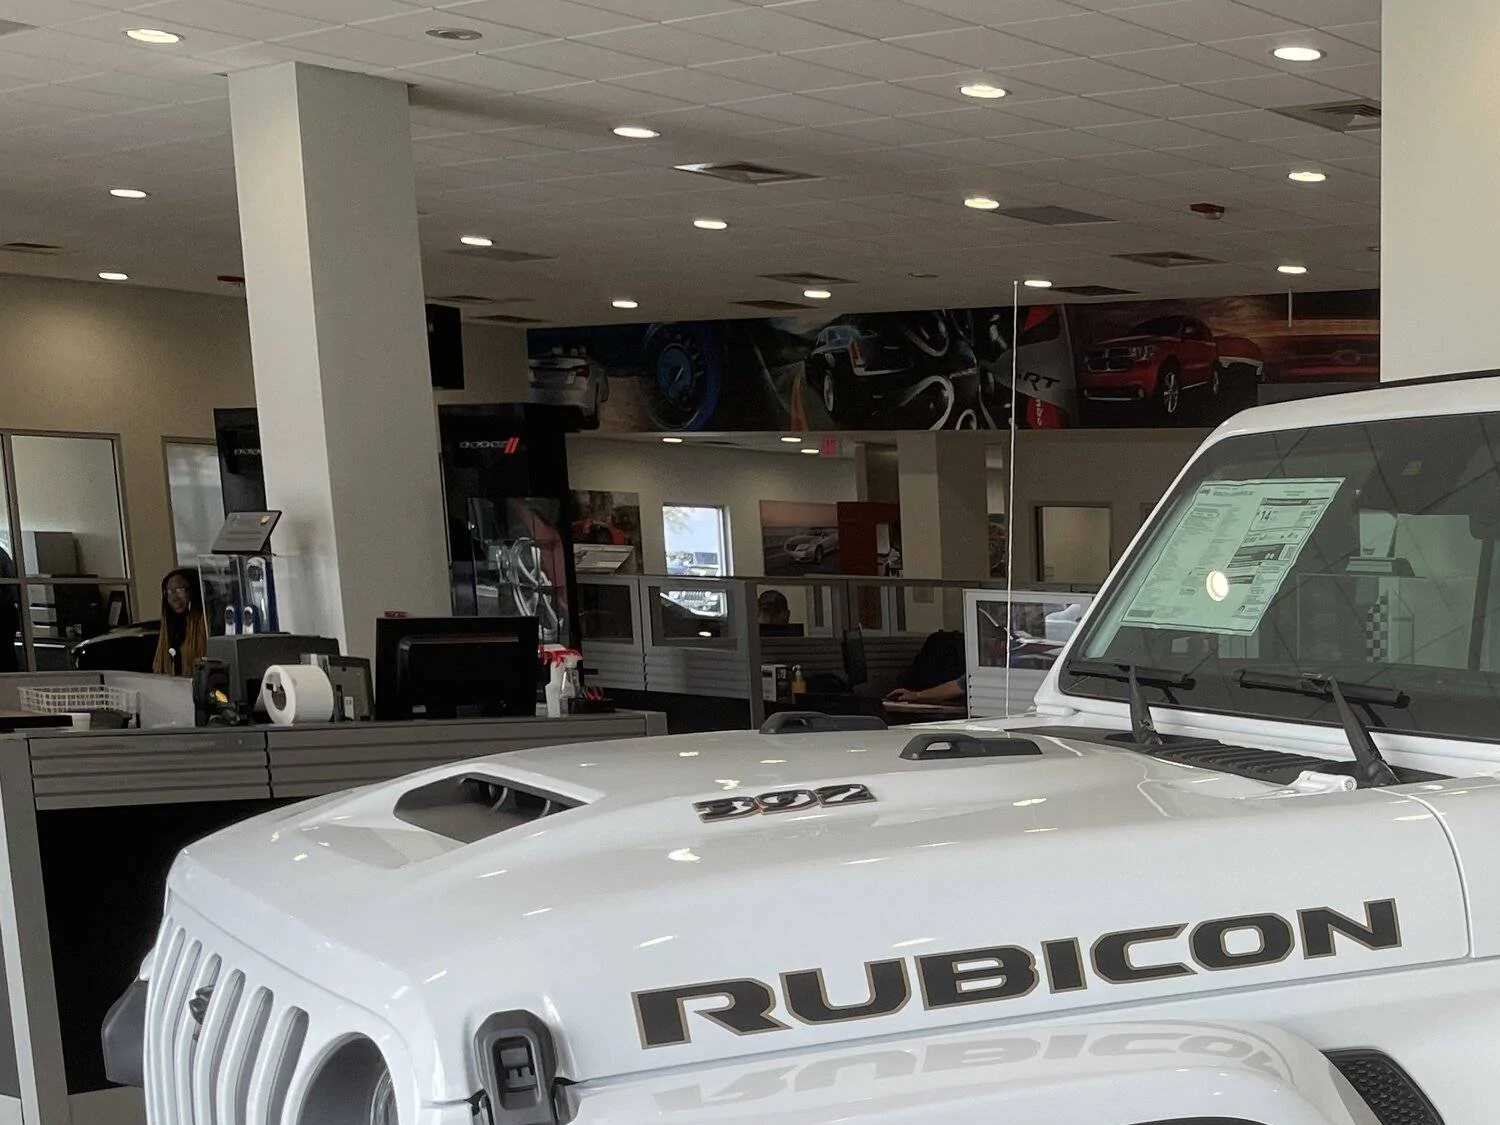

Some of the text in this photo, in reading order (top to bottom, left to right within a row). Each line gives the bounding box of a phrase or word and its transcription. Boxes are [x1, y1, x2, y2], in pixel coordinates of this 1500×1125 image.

[1018, 370, 1060, 391] RT
[693, 784, 877, 823] 392
[632, 897, 1402, 1050] RUBICON
